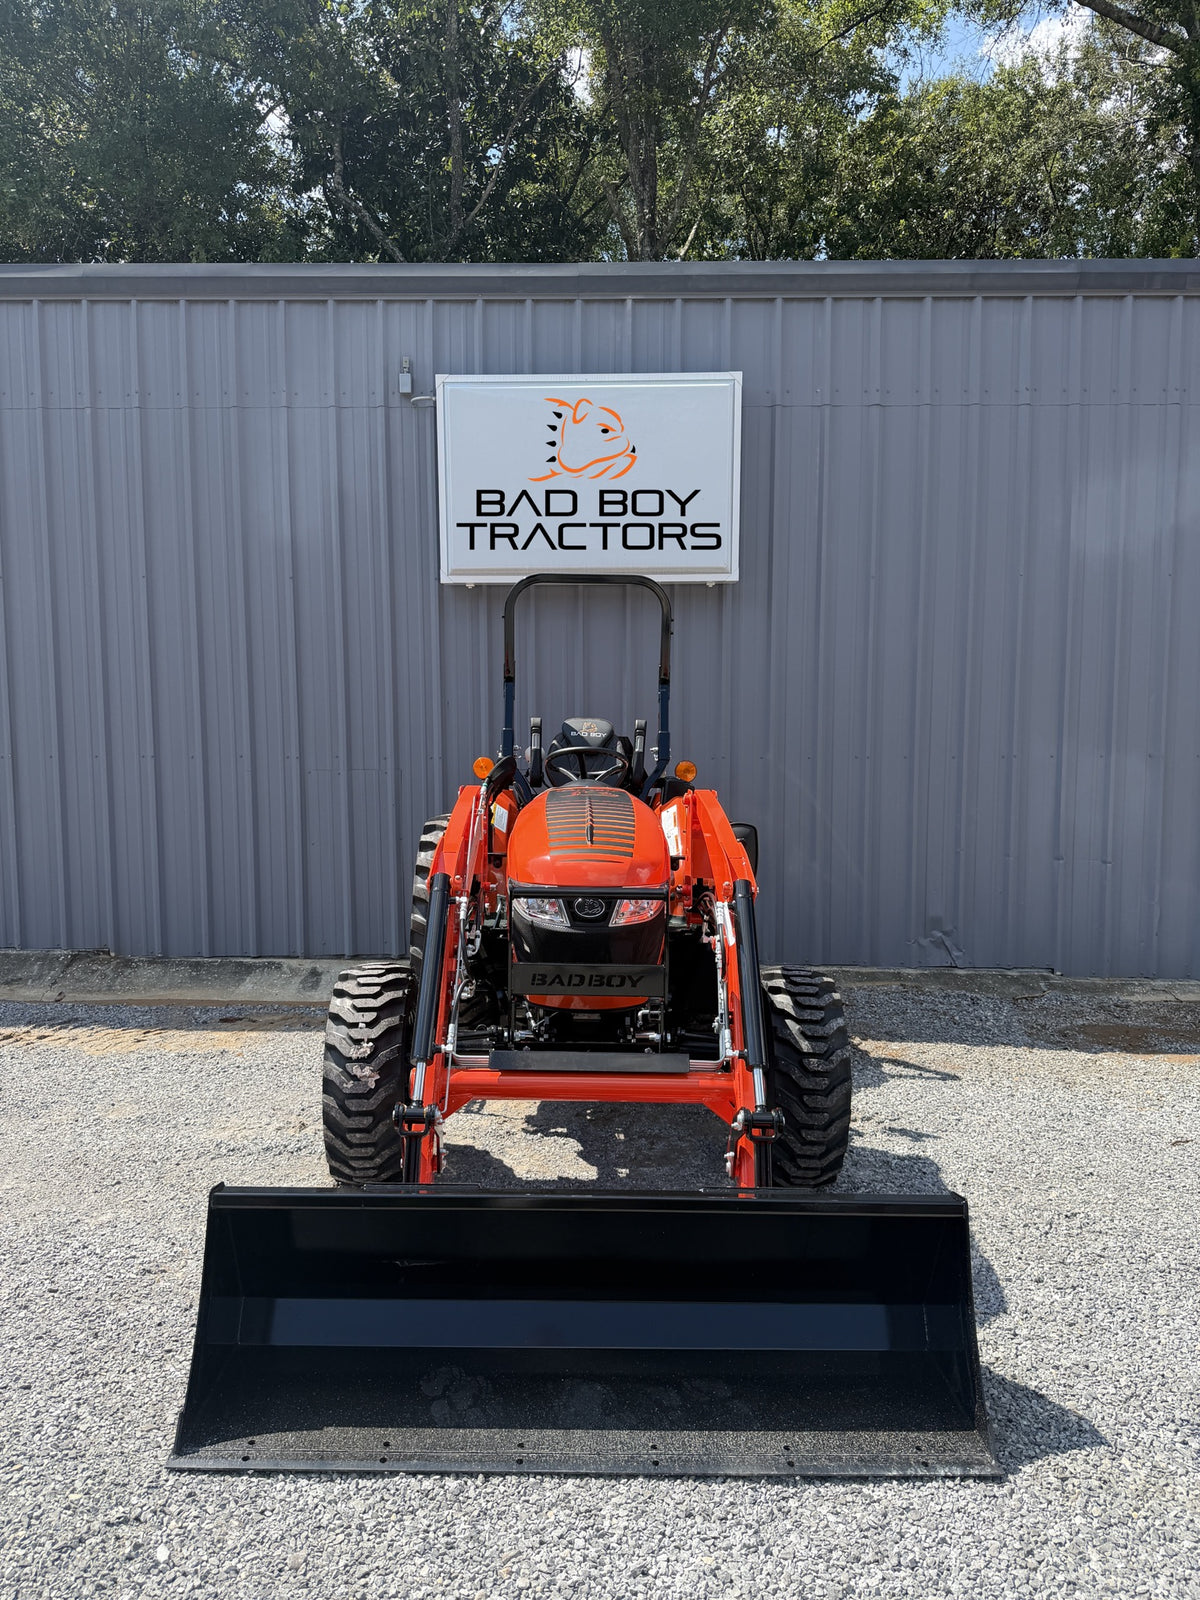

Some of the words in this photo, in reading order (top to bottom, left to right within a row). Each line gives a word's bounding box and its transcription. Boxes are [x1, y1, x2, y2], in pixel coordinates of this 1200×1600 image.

[476, 489, 578, 517] BAD
[598, 489, 701, 517] BOY
[456, 522, 722, 551] TRACTORS
